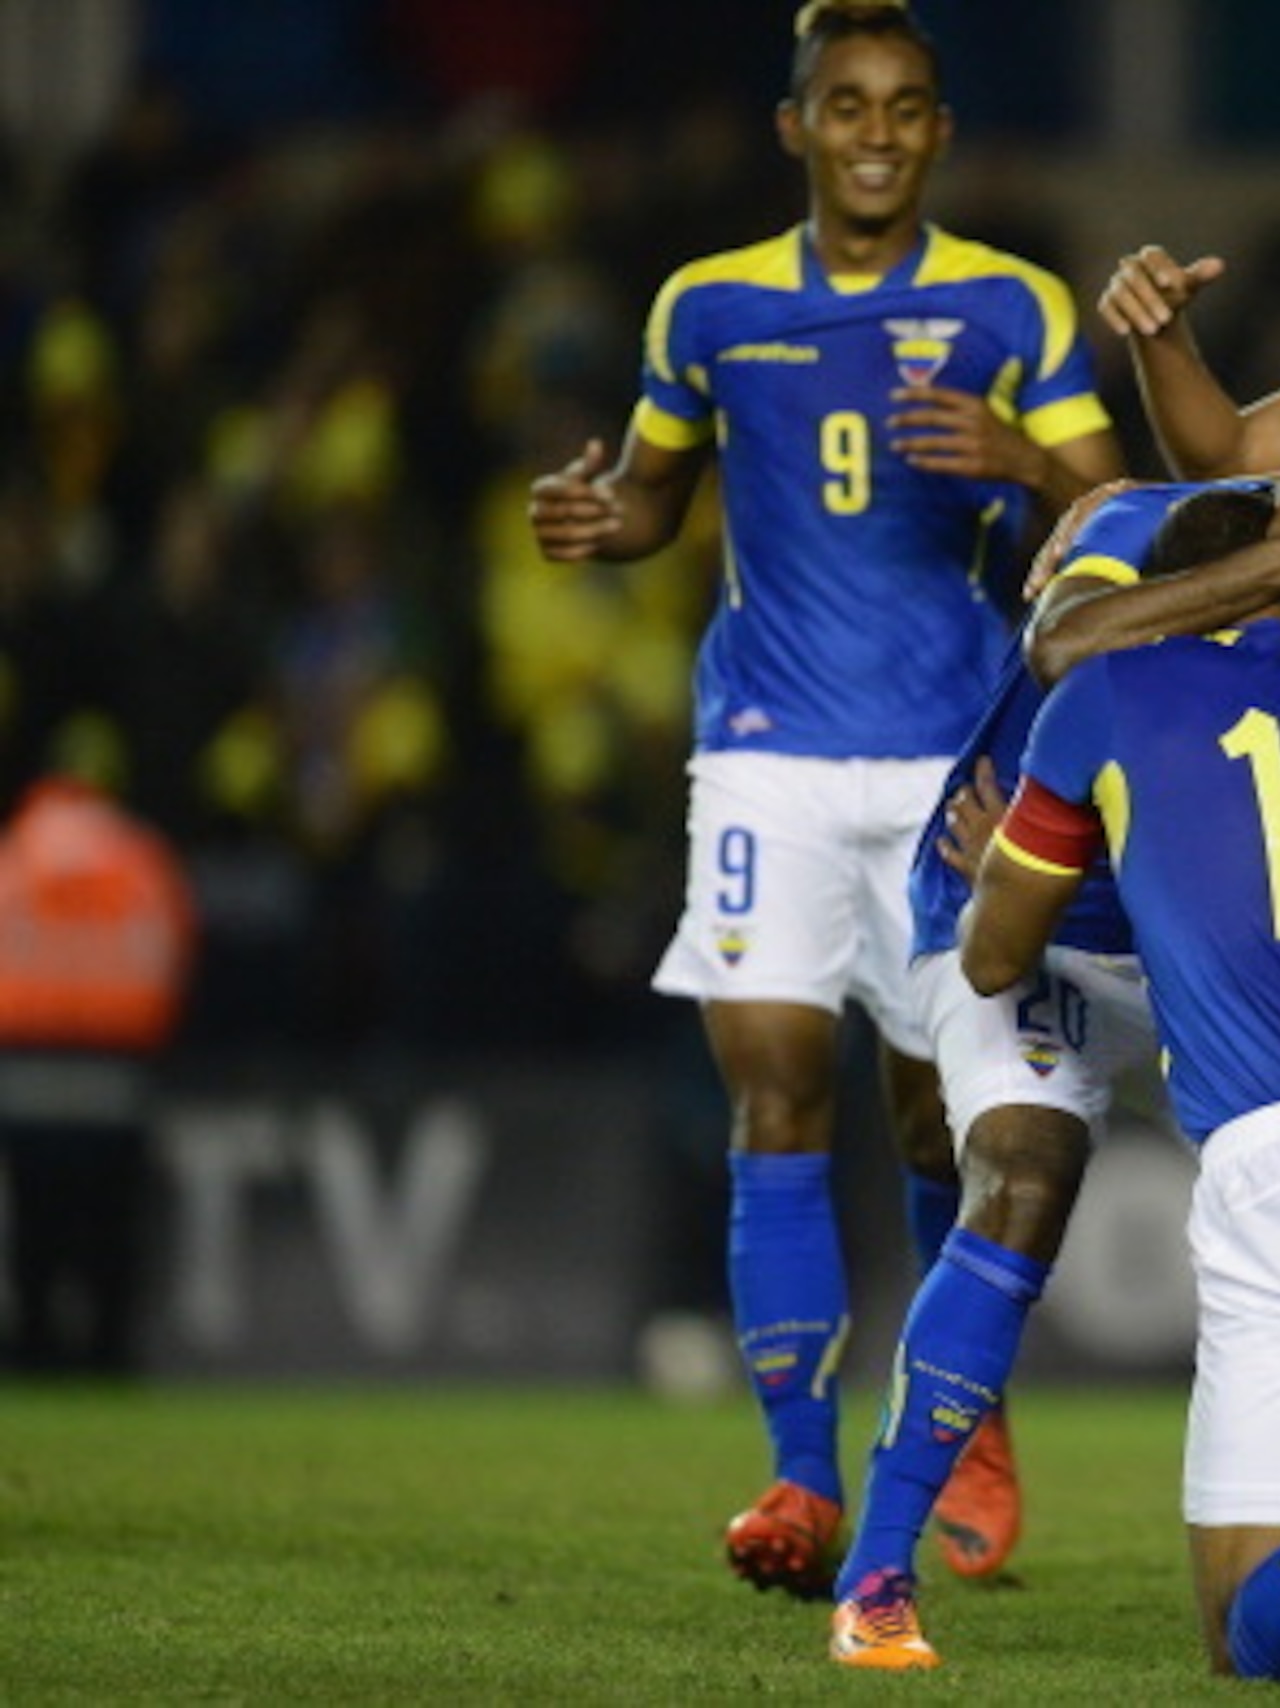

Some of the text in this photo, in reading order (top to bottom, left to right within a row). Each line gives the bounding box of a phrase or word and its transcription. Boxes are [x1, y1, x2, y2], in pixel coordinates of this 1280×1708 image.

[820, 410, 870, 515] 9
[717, 826, 756, 915] 9
[1017, 968, 1088, 1054] 20
